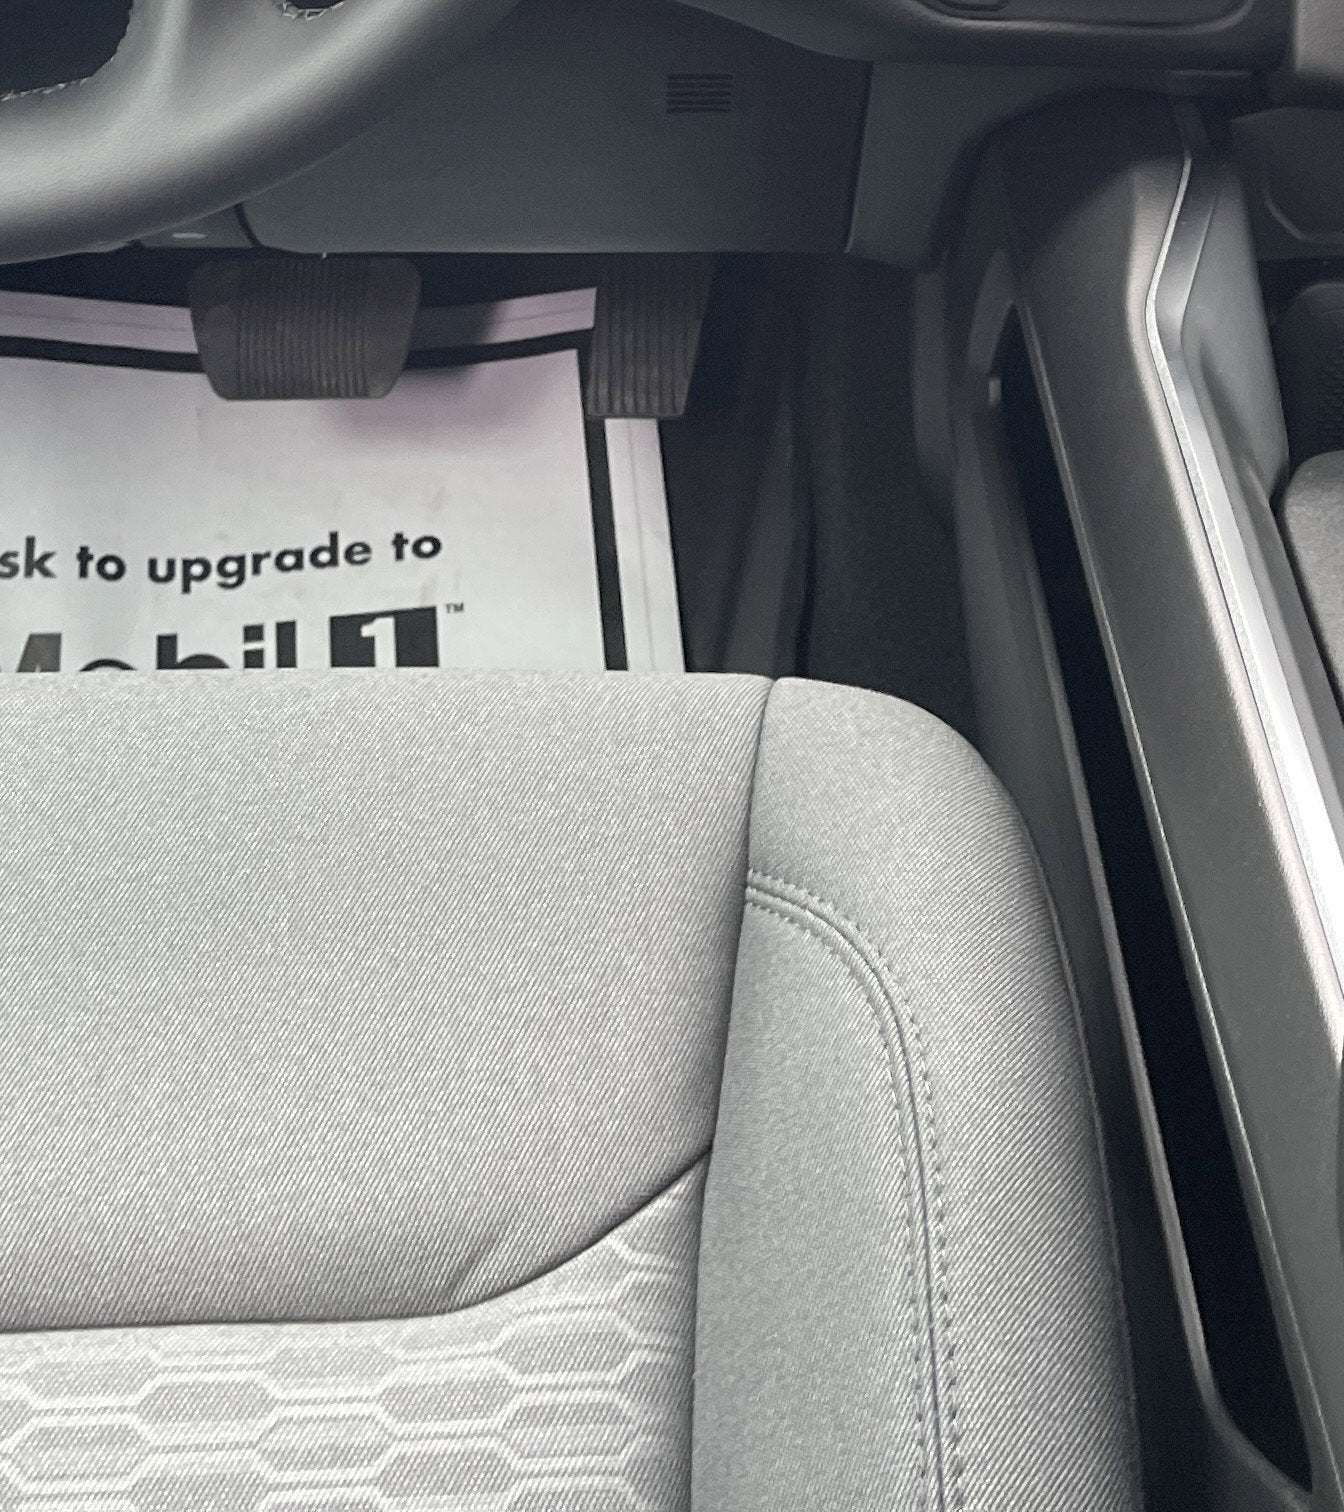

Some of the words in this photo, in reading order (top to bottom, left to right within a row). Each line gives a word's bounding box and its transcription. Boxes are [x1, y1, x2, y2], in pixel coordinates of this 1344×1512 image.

[76, 545, 127, 581] to
[148, 530, 373, 594] upgrade
[392, 531, 443, 562] to
